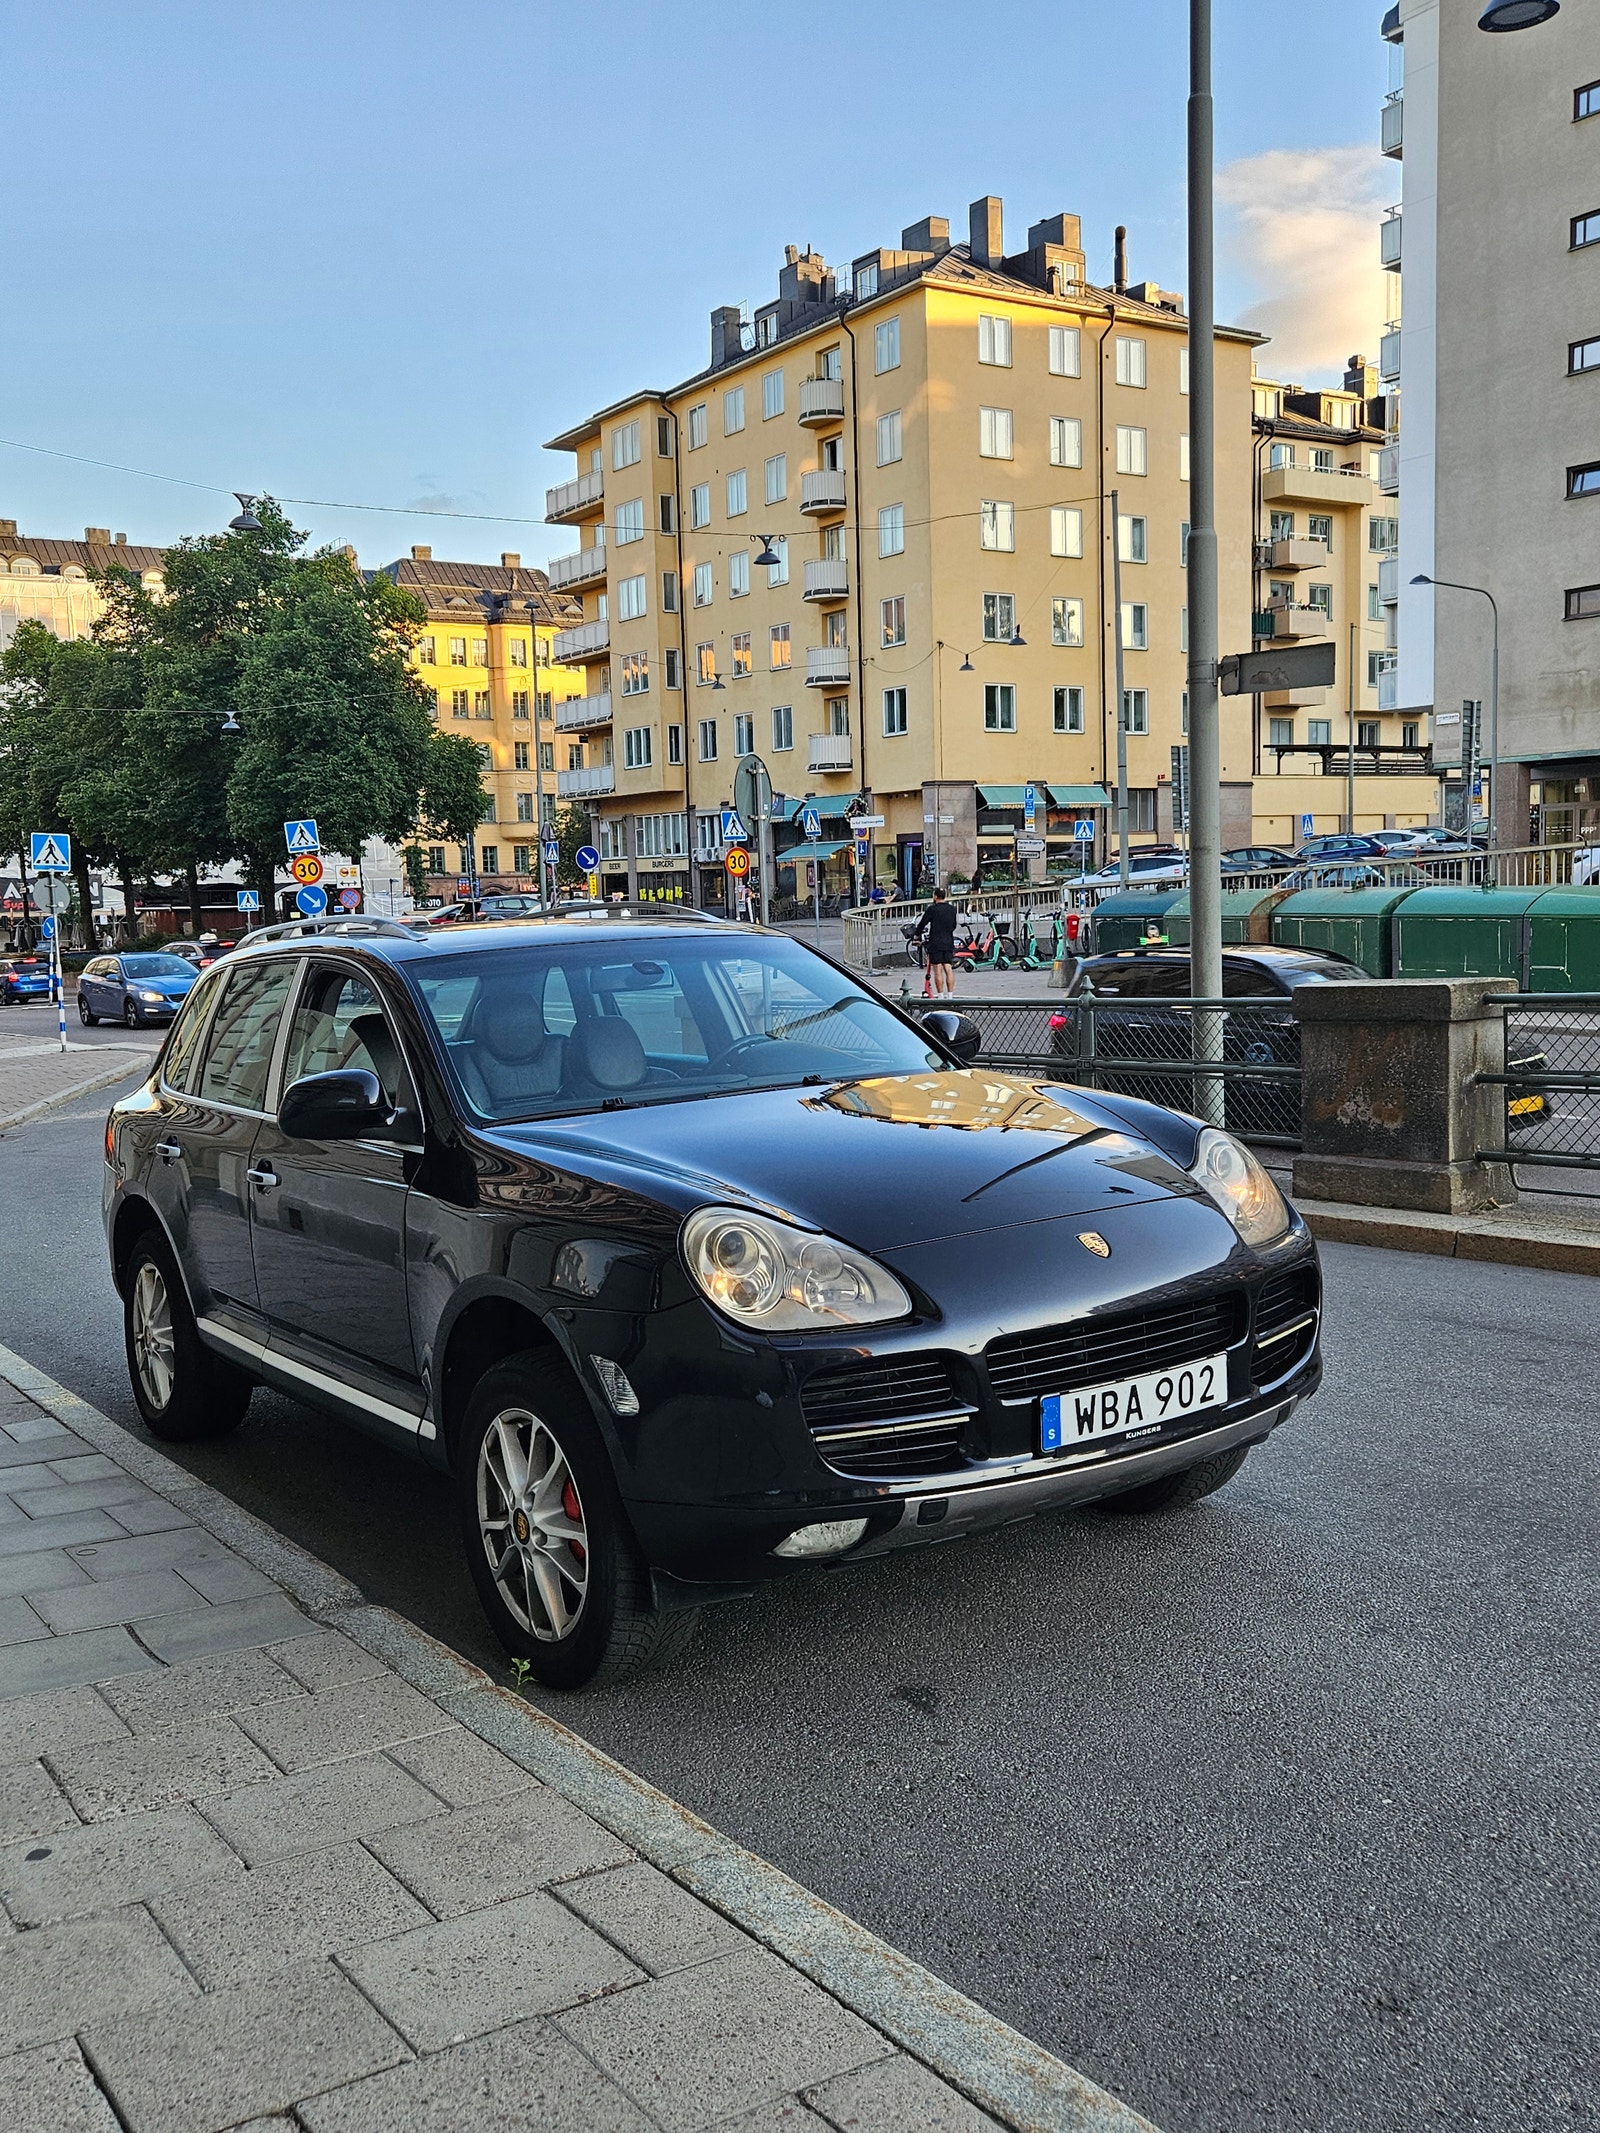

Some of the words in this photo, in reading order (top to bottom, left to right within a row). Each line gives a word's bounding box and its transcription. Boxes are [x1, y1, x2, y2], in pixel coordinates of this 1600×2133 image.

[1026, 788, 1032, 799] P
[730, 855, 746, 869] 30
[297, 862, 318, 878] 30
[1075, 1384, 1144, 1436] WBA
[1155, 1364, 1215, 1416] 902
[1048, 1428, 1056, 1440] S
